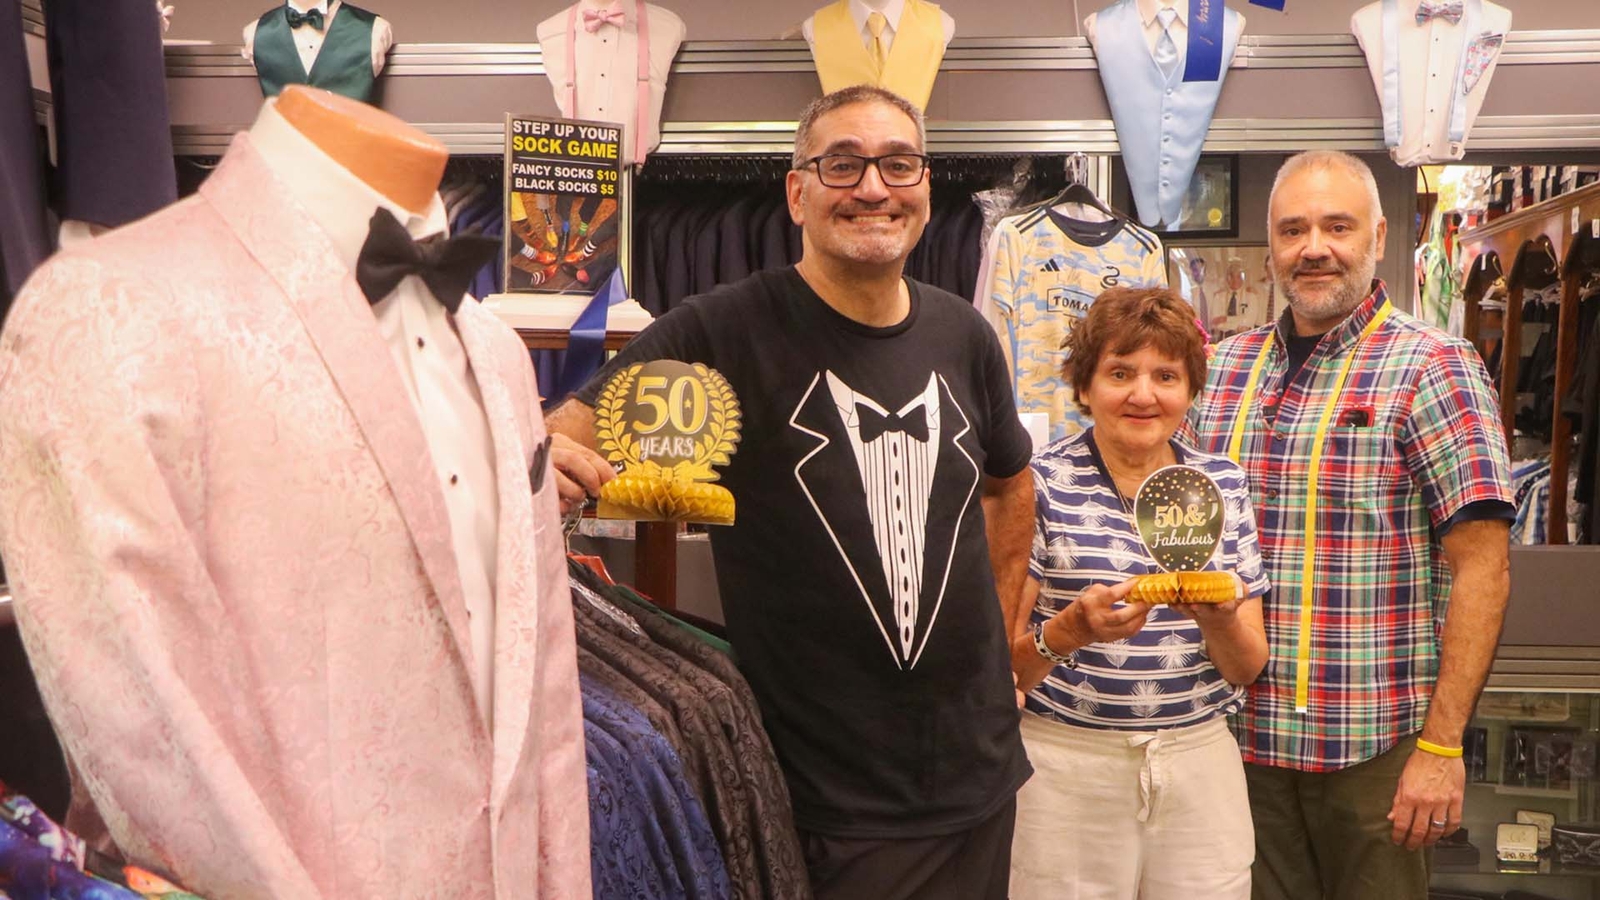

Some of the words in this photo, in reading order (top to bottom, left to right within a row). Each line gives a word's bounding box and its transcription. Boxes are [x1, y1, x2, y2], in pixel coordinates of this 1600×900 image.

[513, 120, 551, 136] STEP
[554, 124, 575, 139] UP
[579, 126, 619, 142] YOUR
[513, 136, 563, 155] SOCK
[567, 141, 617, 159] GAME
[512, 163, 551, 176] FANCY
[554, 167, 594, 179] SOCKS
[596, 169, 617, 182] $10
[515, 178, 554, 191] BLACK
[558, 181, 598, 194] SOCKS
[600, 183, 615, 195] $5
[1053, 295, 1089, 312] TOMA
[632, 375, 709, 435] 50
[1151, 528, 1216, 549] Fabulous
